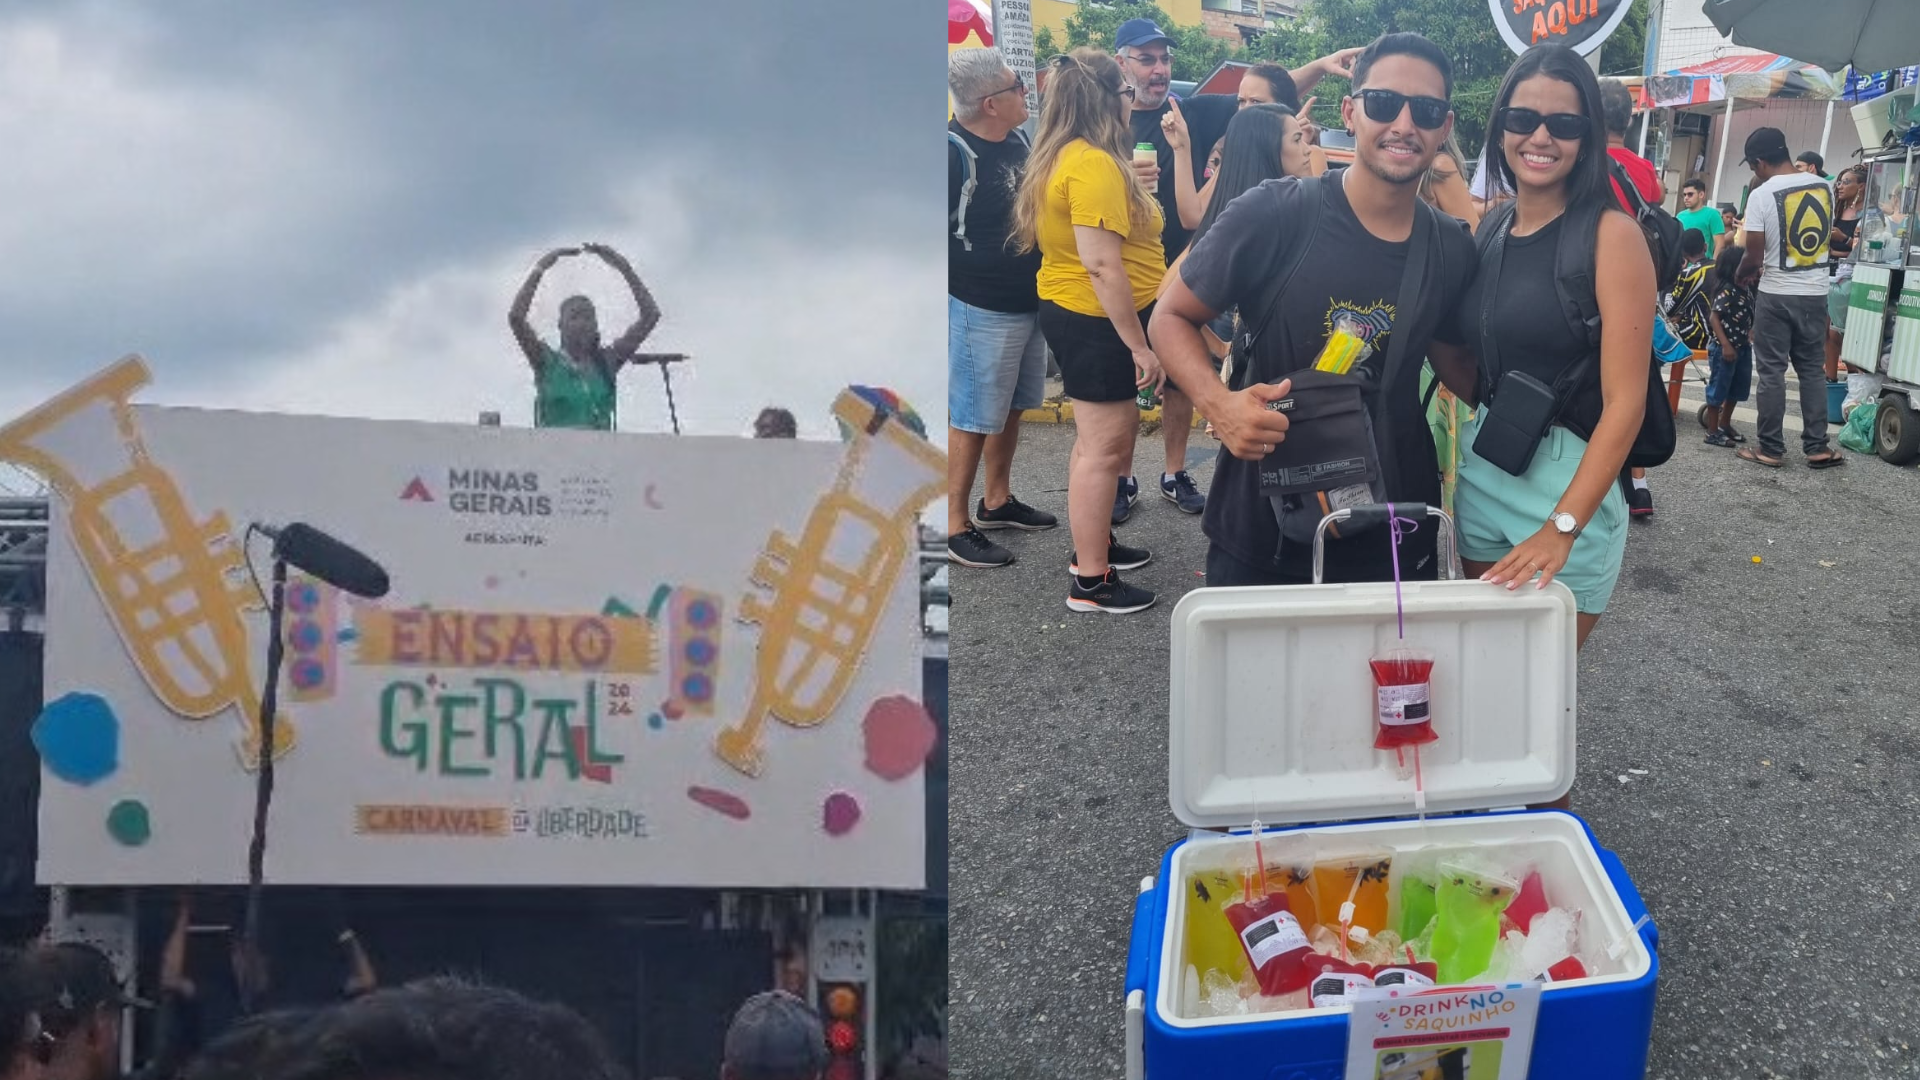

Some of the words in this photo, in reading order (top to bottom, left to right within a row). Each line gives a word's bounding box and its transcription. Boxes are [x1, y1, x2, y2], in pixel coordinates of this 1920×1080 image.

[1532, 0, 1598, 44] AQUI
[449, 469, 539, 492] MINAS
[449, 492, 553, 517] GERAIS
[391, 611, 613, 669] ENSAIO
[379, 678, 625, 781] GERAL
[365, 808, 500, 833] CARNAVAL
[537, 807, 649, 839] LIBERDADE
[1404, 1000, 1515, 1031] SAQUINHO
